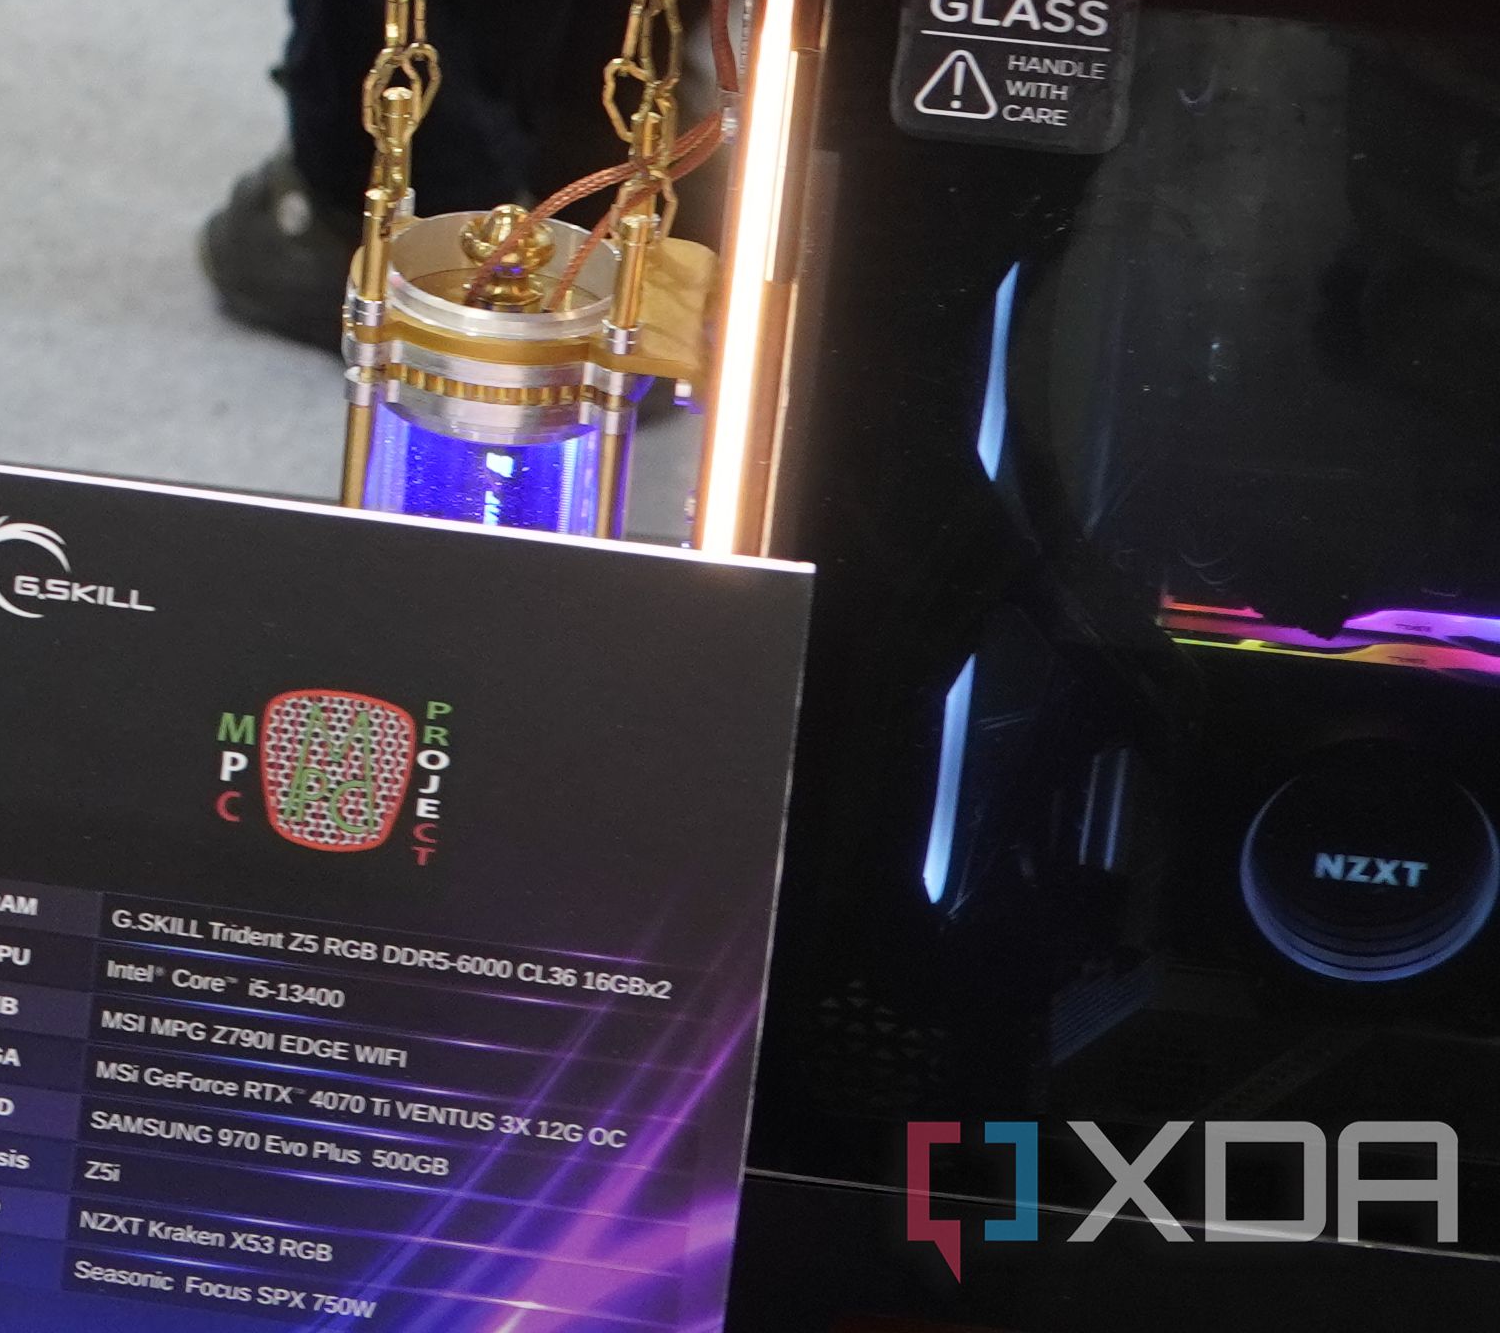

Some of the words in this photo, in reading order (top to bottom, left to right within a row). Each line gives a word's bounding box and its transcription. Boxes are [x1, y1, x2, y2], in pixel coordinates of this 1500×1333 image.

[1005, 79, 1069, 101] WITH
[1007, 54, 1108, 80] HANDLE
[1001, 104, 1069, 127] CARE
[13, 573, 157, 612] G.SKILL
[216, 711, 256, 823] MPC
[411, 700, 454, 867] PROJECT
[1313, 851, 1430, 889] NZXT
[111, 908, 205, 939] G.SKILL
[209, 921, 285, 950] Trident
[288, 931, 320, 954] Z5
[323, 937, 379, 961] RGB
[382, 944, 513, 980] DDR5-6000
[516, 962, 578, 988] CL36
[582, 970, 673, 1000] 16GBx2
[247, 977, 346, 1008] i5-13400
[101, 1010, 146, 1033] MSI
[151, 1017, 207, 1041] MPG
[210, 1024, 275, 1051] Z790I
[280, 1033, 351, 1062] EDGE
[354, 1043, 408, 1069] WIFI
[96, 1060, 140, 1083] MSi
[143, 1066, 240, 1097] GeForce
[308, 1089, 367, 1114] 4070
[370, 1097, 391, 1118] Ti
[396, 1101, 496, 1132] VENTUS
[500, 1114, 531, 1137] 3X
[536, 1120, 584, 1144] 12G
[587, 1126, 629, 1149] OC
[89, 1110, 214, 1145] SAMSUNG
[217, 1128, 261, 1152] 970
[264, 1134, 308, 1158] Evo
[312, 1140, 362, 1166] Plus
[371, 1149, 450, 1177] 500GB
[83, 1159, 122, 1182] Z5i
[79, 1210, 145, 1236] NZXT
[147, 1220, 226, 1248] Kraken
[228, 1231, 275, 1255] X53
[279, 1237, 334, 1263] RGB
[73, 1260, 175, 1291] Seasonic
[184, 1275, 253, 1303] Focus
[256, 1286, 307, 1311] SPX
[311, 1292, 378, 1319] 750W
